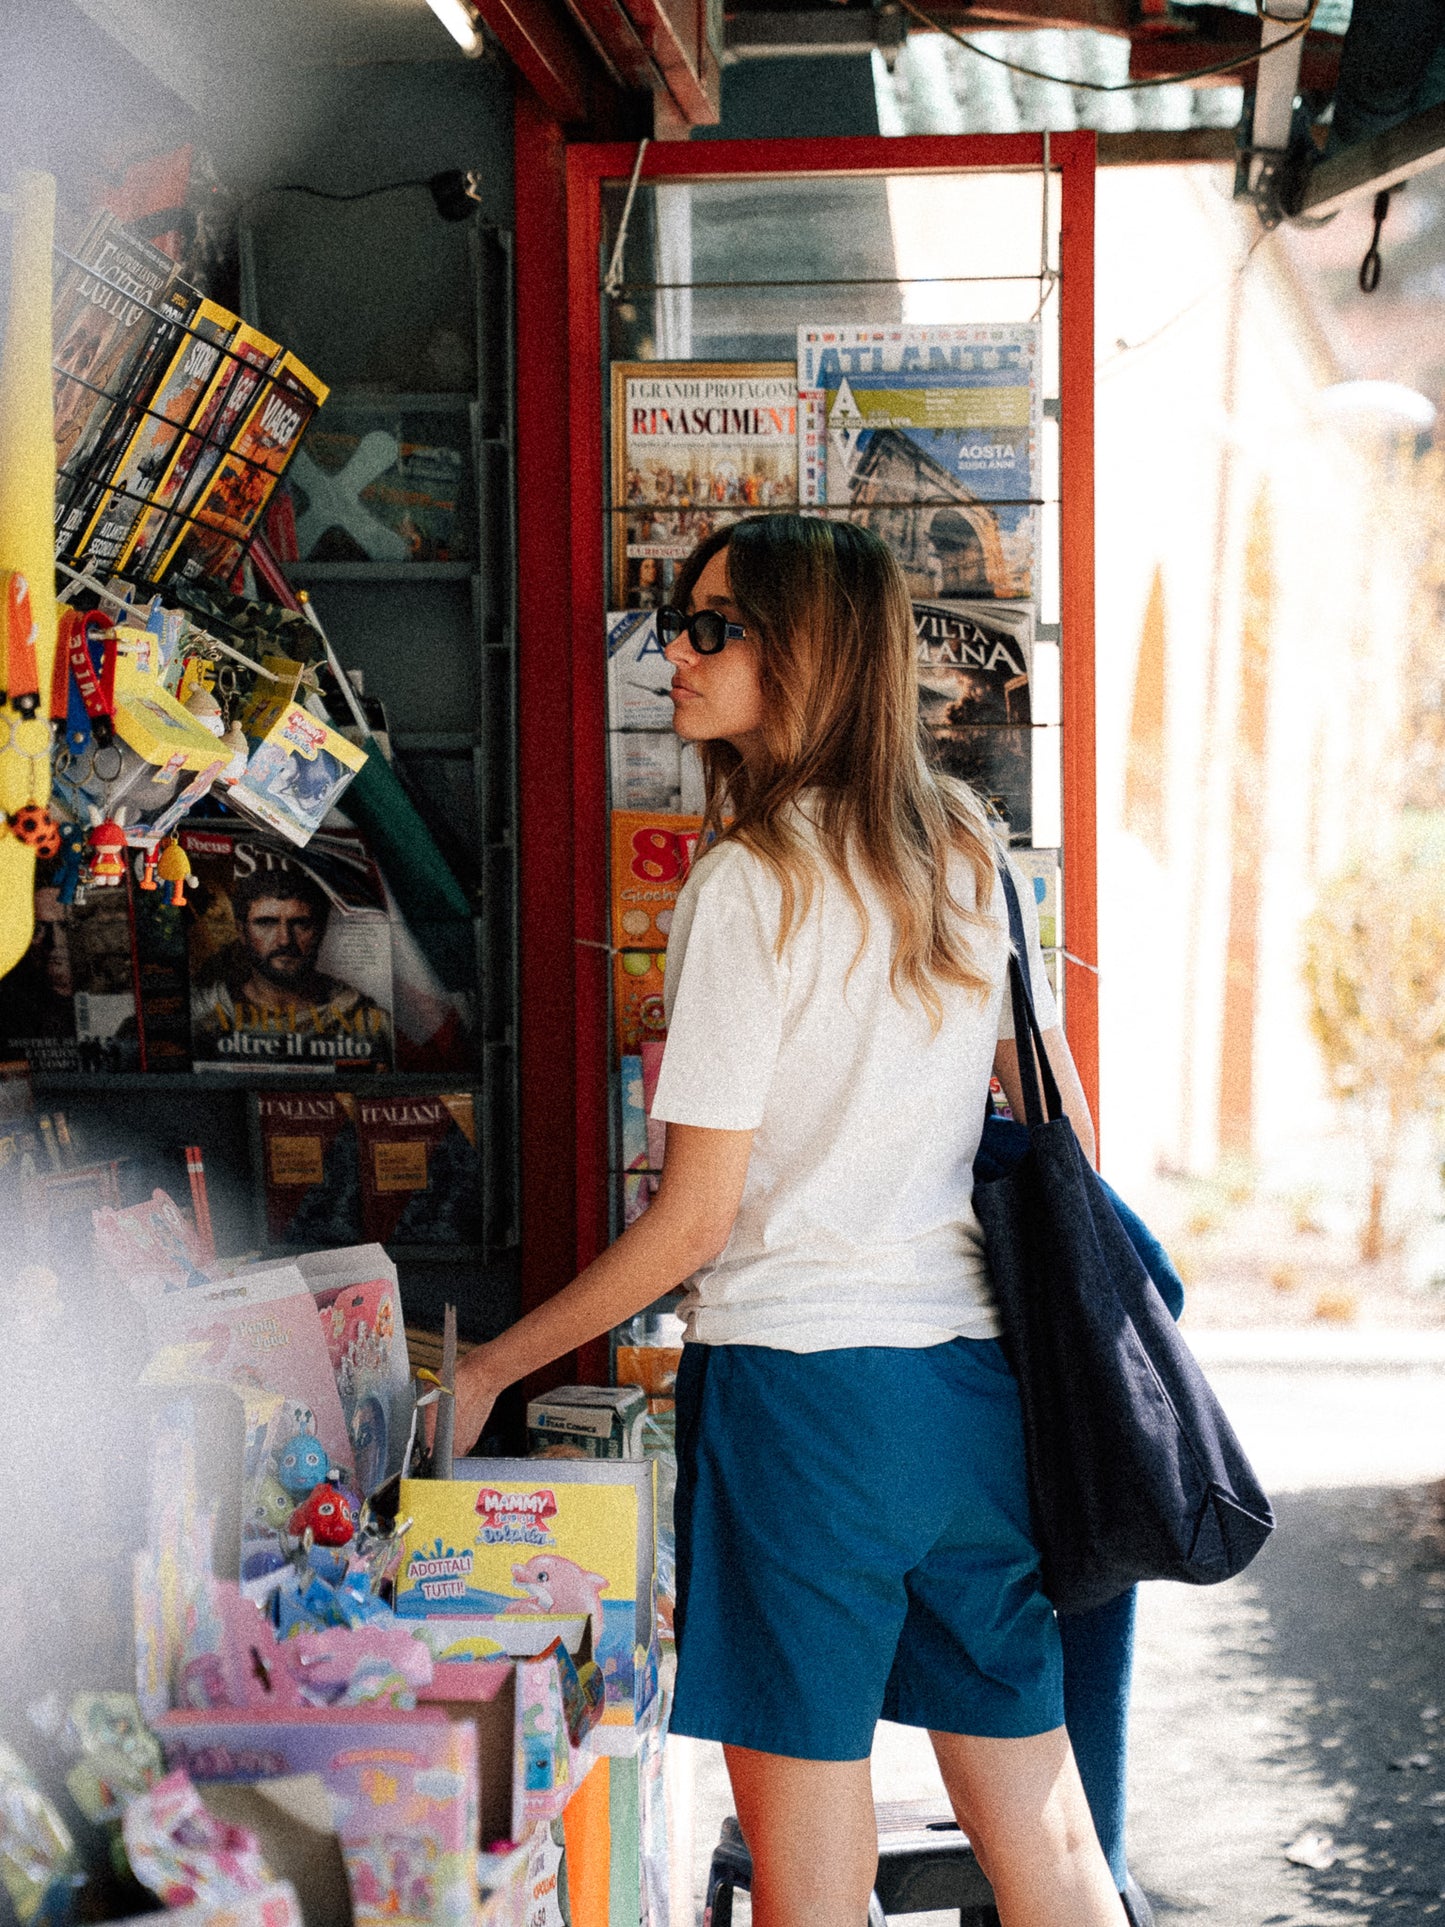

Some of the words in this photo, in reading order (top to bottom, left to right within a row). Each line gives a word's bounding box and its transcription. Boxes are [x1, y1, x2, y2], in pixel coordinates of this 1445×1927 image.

[817, 346, 1022, 374] ATLANTE
[639, 382, 700, 398] GRANDI
[704, 382, 799, 398] PROTAGONIS
[260, 393, 302, 448] VIAGGI
[632, 407, 797, 435] RINASCIMENT
[958, 445, 1015, 458] AOSTA
[911, 616, 990, 645] VILTA
[918, 640, 1025, 675] MANA
[186, 836, 231, 854] Focus
[206, 1002, 382, 1034] ADRIANO
[217, 1033, 281, 1054] oltre
[286, 1033, 303, 1055] il
[310, 1033, 372, 1057] mito
[484, 1494, 549, 1513] MAMMY
[409, 1556, 472, 1577] ADOTTALI
[423, 1579, 466, 1599] TUTTI!
